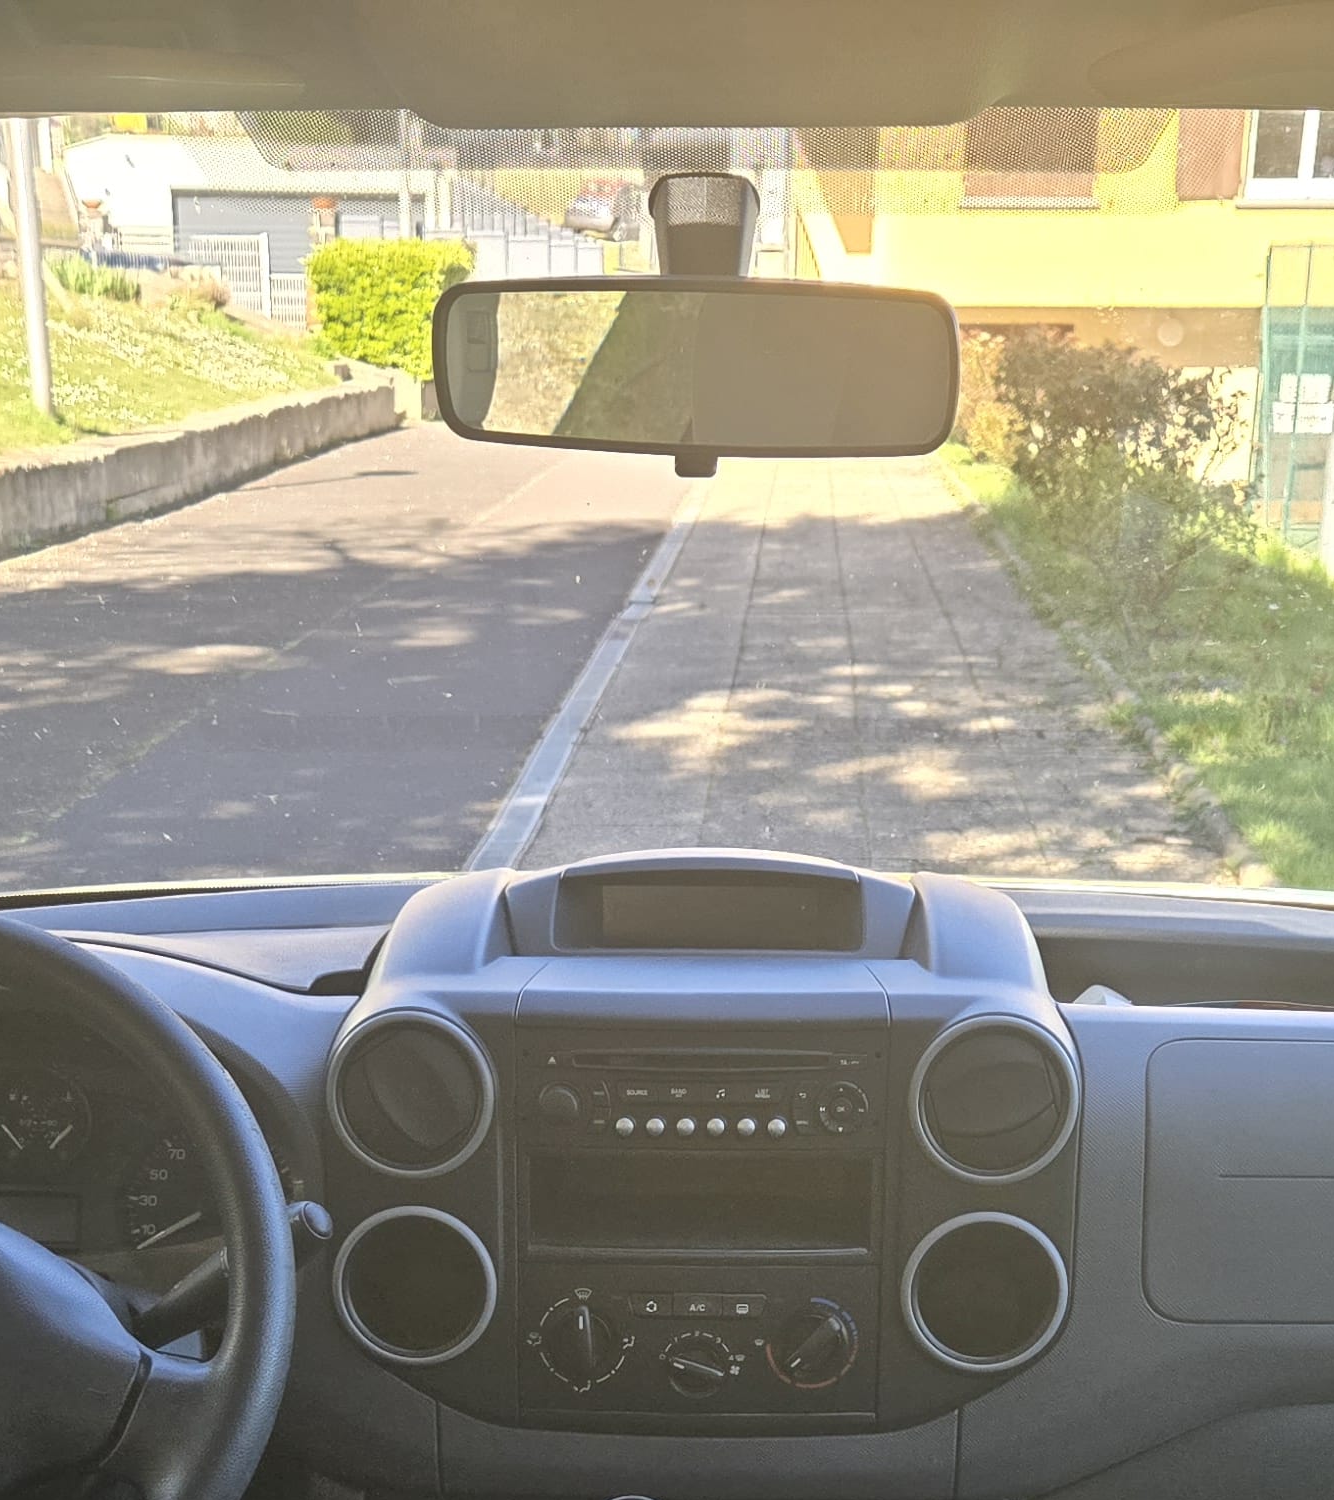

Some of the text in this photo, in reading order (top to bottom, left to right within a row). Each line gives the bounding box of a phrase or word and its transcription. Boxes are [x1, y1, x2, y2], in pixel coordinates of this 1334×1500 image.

[167, 1148, 186, 1160] 70
[149, 1169, 168, 1181] 50
[138, 1194, 158, 1207] 30
[140, 1223, 156, 1235] 10
[688, 1303, 707, 1313] A/C
